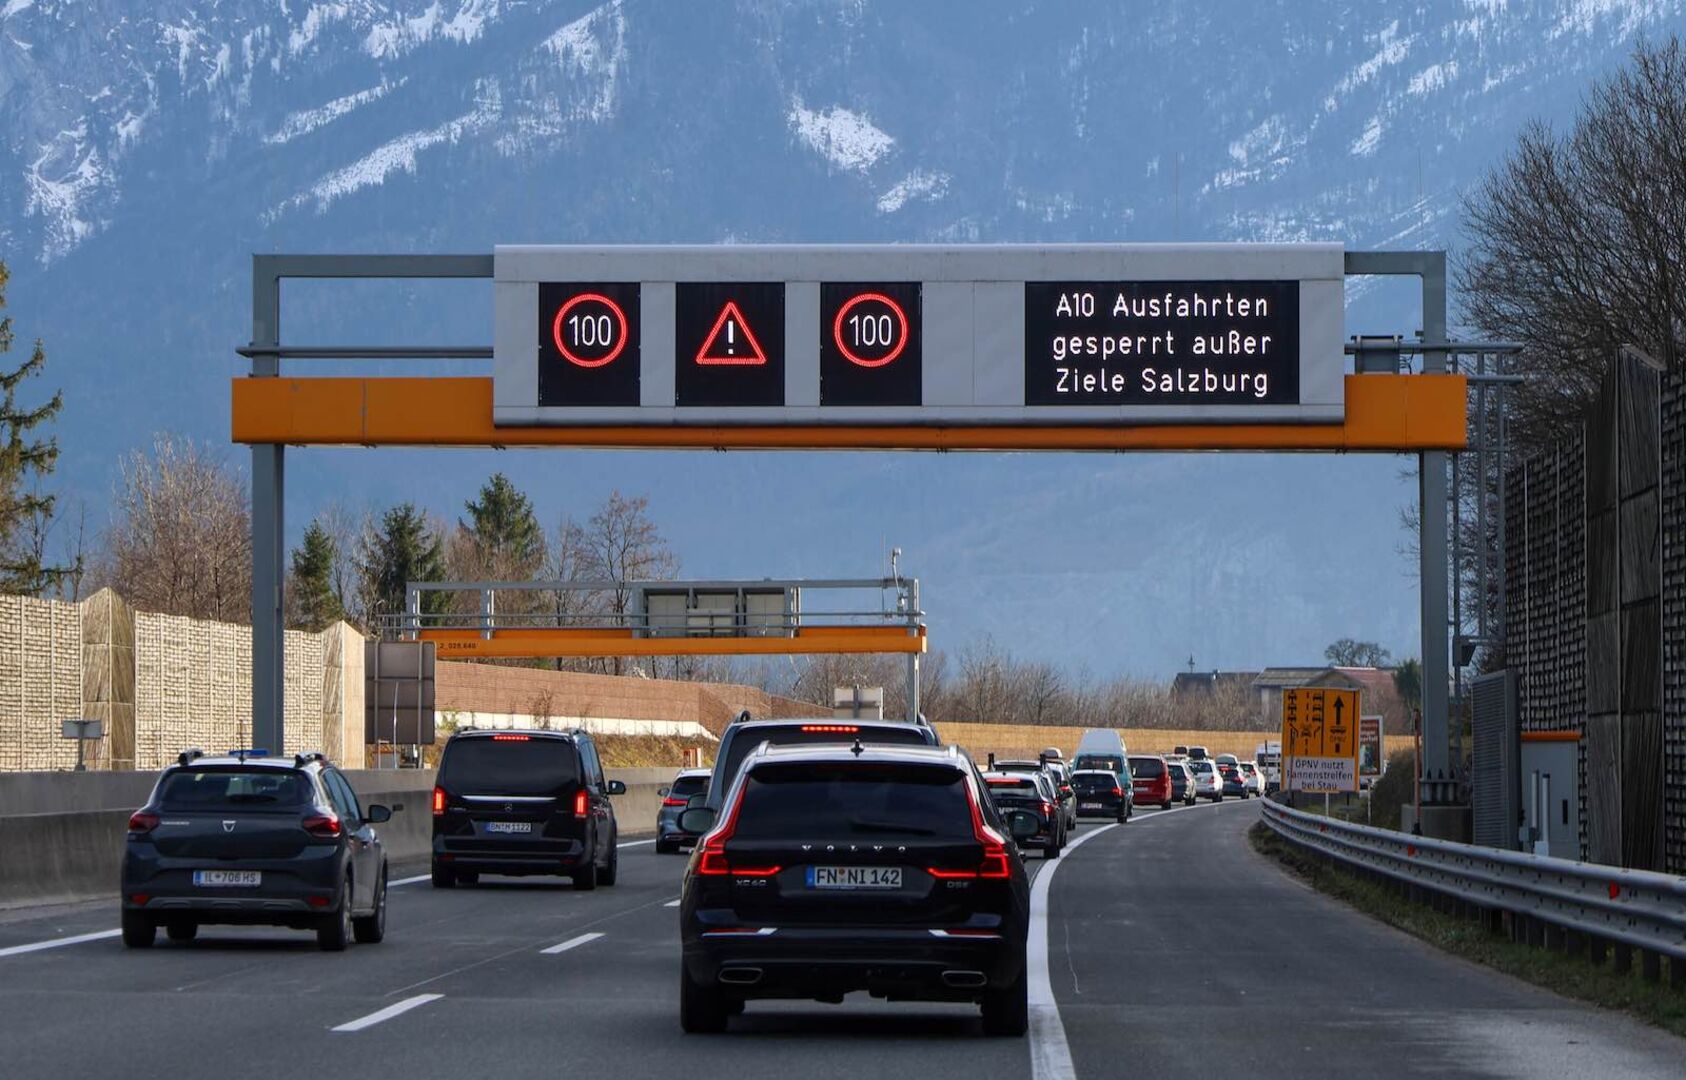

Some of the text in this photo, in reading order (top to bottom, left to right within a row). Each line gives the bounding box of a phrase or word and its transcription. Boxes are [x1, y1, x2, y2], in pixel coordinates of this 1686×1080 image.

[1056, 292, 1268, 317] A10 Ausfahrten
[568, 314, 612, 347] 100
[849, 314, 893, 347] 100
[1052, 330, 1272, 361] gesperrt außer
[1056, 367, 1268, 398] Ziele Salzburg
[1321, 760, 1344, 770] nutzt
[1301, 780, 1337, 790] bei Stau
[870, 868, 900, 886] 142
